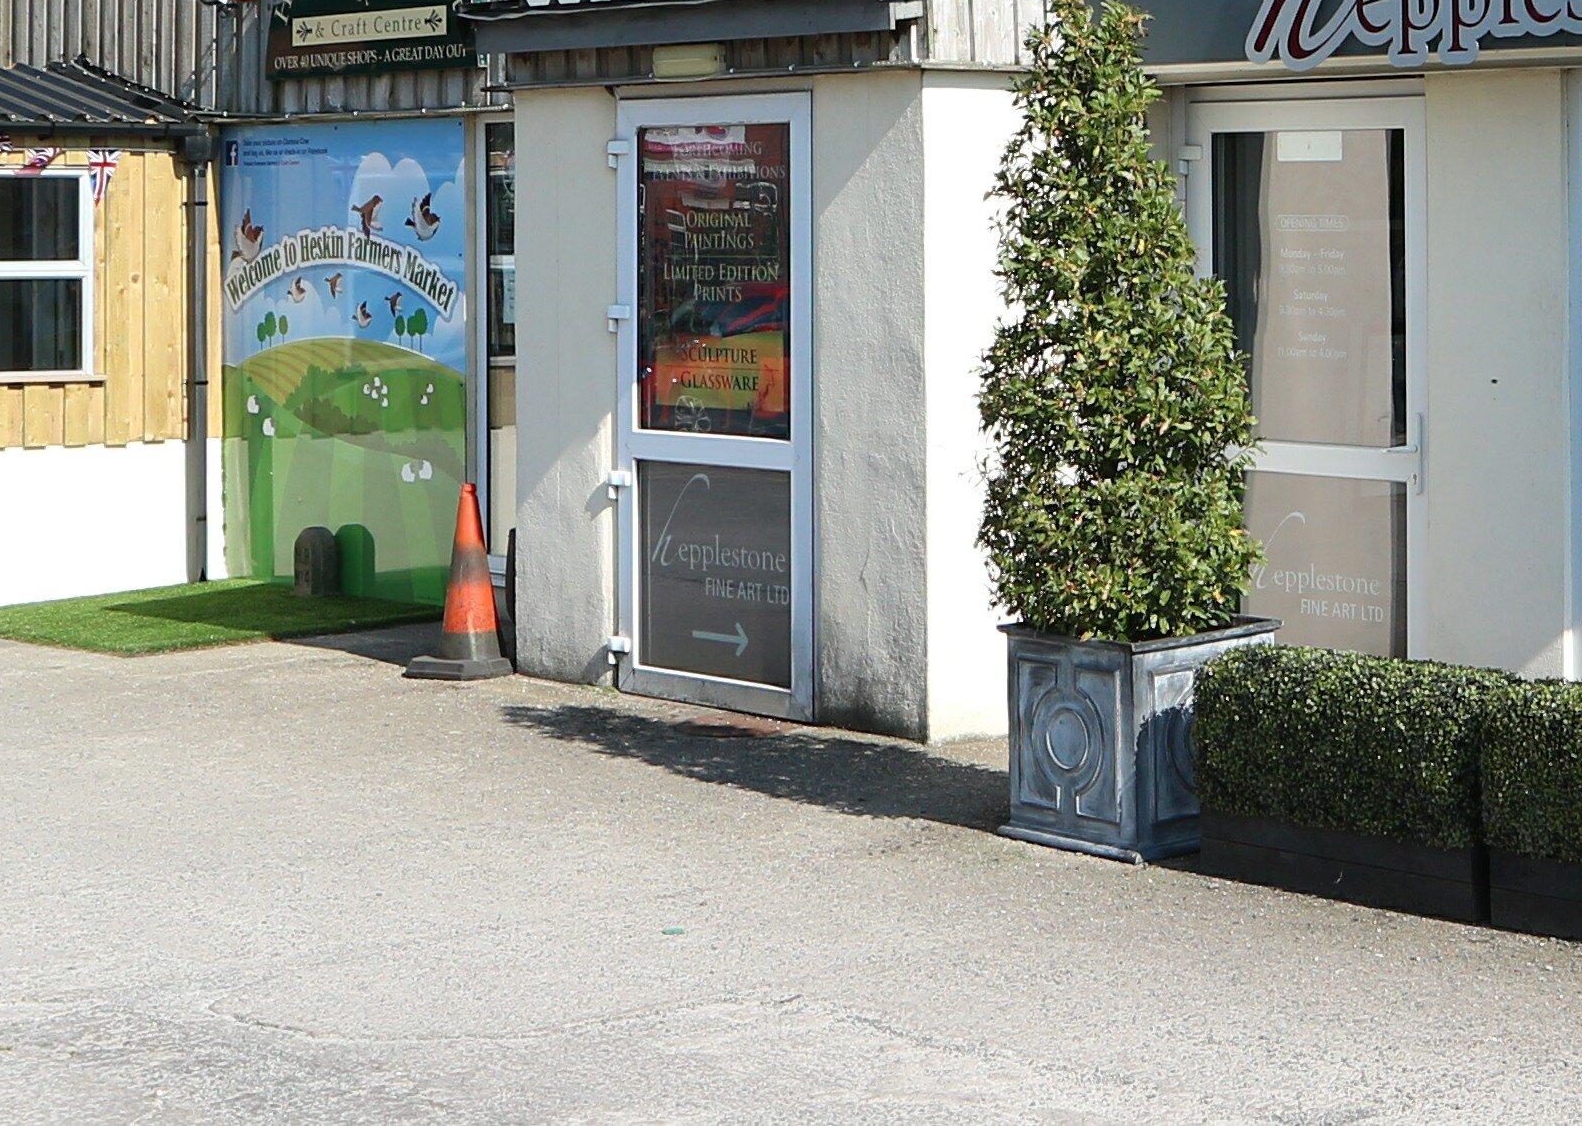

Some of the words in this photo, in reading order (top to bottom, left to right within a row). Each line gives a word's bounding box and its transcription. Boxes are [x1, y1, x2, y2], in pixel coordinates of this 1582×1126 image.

[331, 15, 369, 37] Craft
[373, 12, 422, 35] Centre
[274, 54, 299, 70] OVER
[310, 52, 347, 69] UNIQUE
[384, 49, 392, 62] A
[392, 47, 424, 62] GREAT
[425, 44, 445, 60] DAY
[684, 231, 754, 250] PAINTINGS
[226, 247, 282, 306] Welcome
[284, 239, 297, 265] to
[300, 230, 344, 263] Heskin
[348, 231, 401, 275] Farmers
[403, 250, 456, 312] Market
[663, 262, 715, 281] LIMITED
[719, 262, 779, 282] EDITION
[694, 284, 742, 302] PRINTS
[681, 345, 758, 364] SCULPTURE
[679, 369, 759, 391] GLASSWARE
[651, 474, 786, 573] hepplestone
[705, 578, 734, 599] FINE
[737, 580, 763, 603] ART
[768, 584, 790, 606] LTD
[1300, 597, 1329, 619] FINE
[1332, 599, 1358, 621] ART
[1361, 601, 1384, 623] LTD
